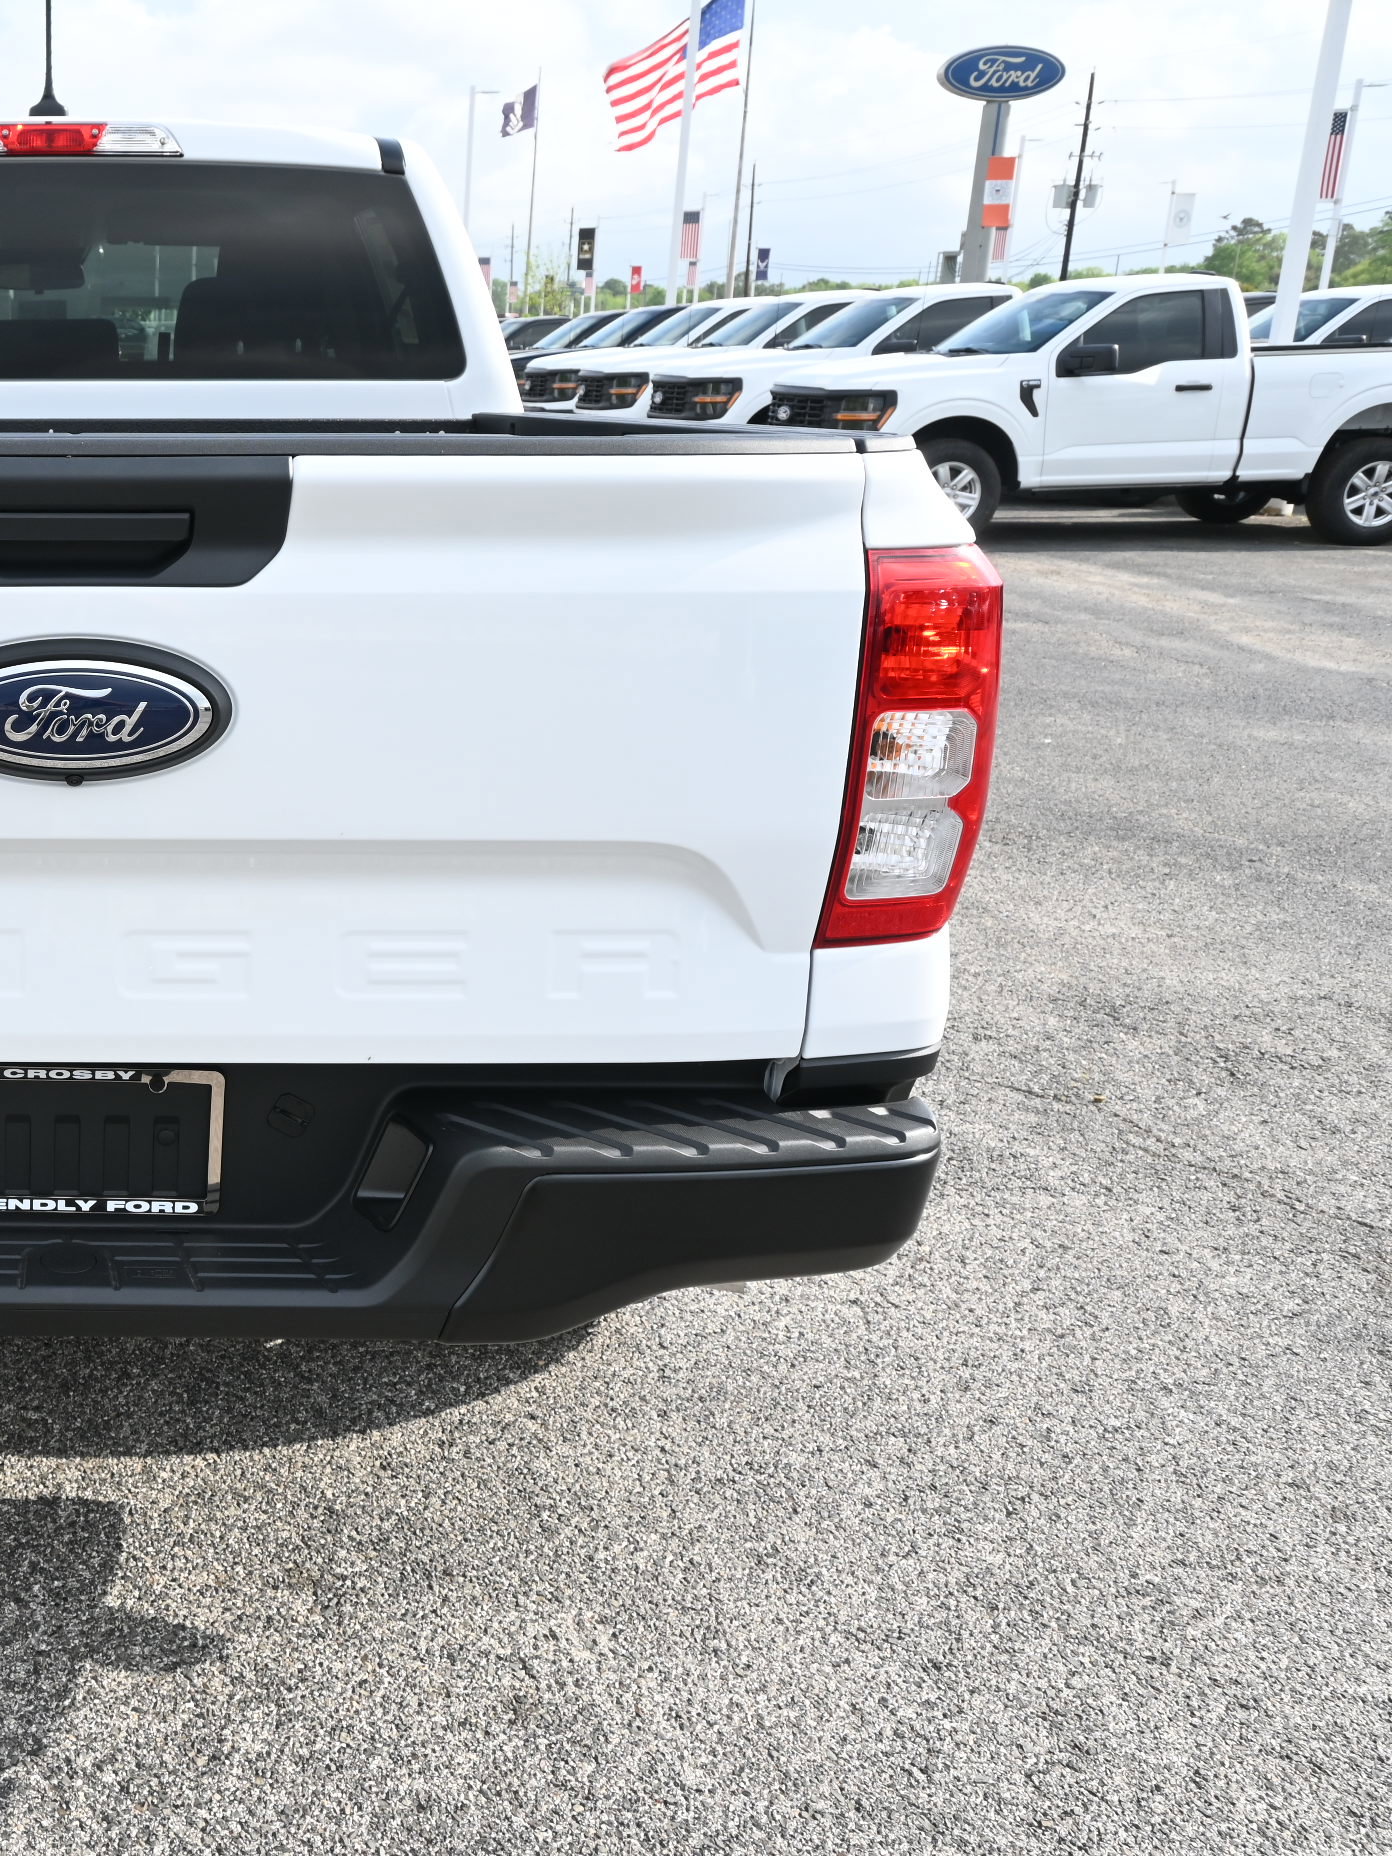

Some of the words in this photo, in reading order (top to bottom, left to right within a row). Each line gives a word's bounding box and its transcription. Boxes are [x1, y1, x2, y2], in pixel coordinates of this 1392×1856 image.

[969, 55, 1044, 88] Ford
[3, 684, 148, 743] Ford
[2, 1068, 136, 1081] CROSBY
[106, 1200, 200, 1214] FORD
